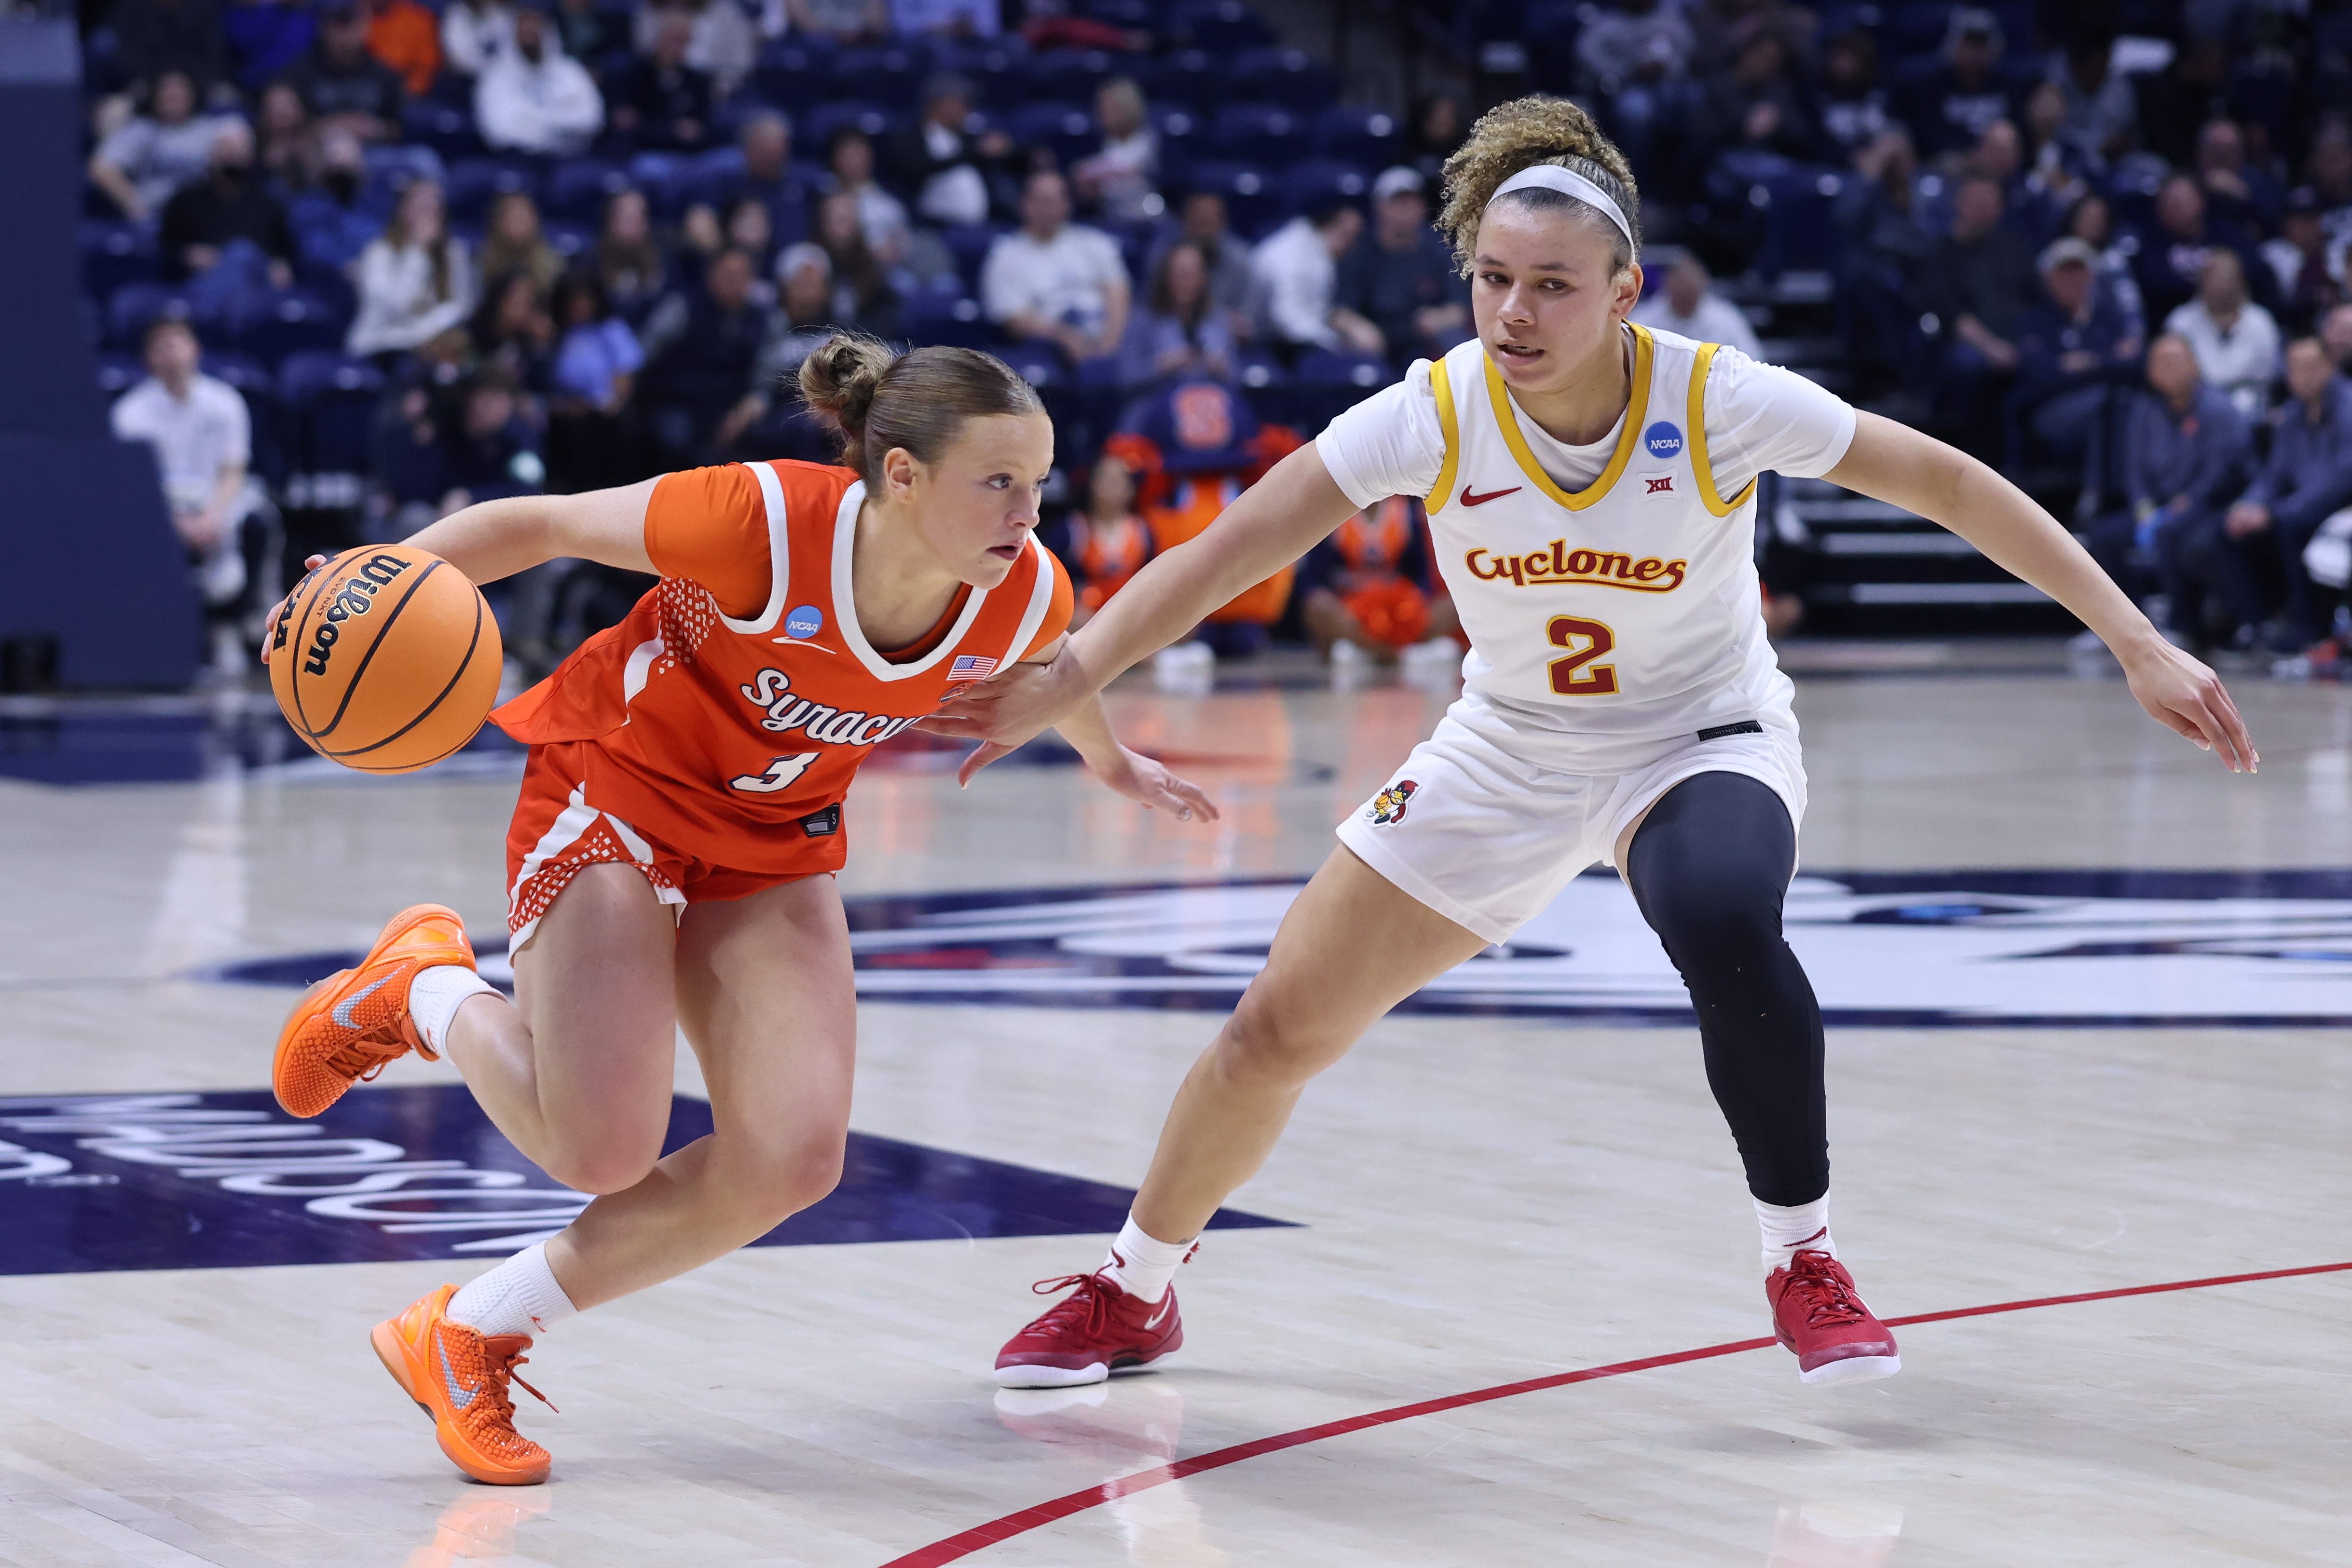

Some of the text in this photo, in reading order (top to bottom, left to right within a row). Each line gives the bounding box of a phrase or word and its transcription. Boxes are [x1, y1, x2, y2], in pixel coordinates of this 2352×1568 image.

[1651, 439, 1680, 450] NCAA
[1645, 476, 1674, 494] XII
[1464, 538, 1688, 594] Cyclones
[303, 554, 414, 677] Wilson
[316, 577, 346, 618] EVO NXT
[788, 620, 819, 632] NCAA
[1545, 614, 1620, 696] 2
[740, 667, 926, 747] Syracu
[728, 751, 822, 792] 3
[832, 813, 837, 825] S
